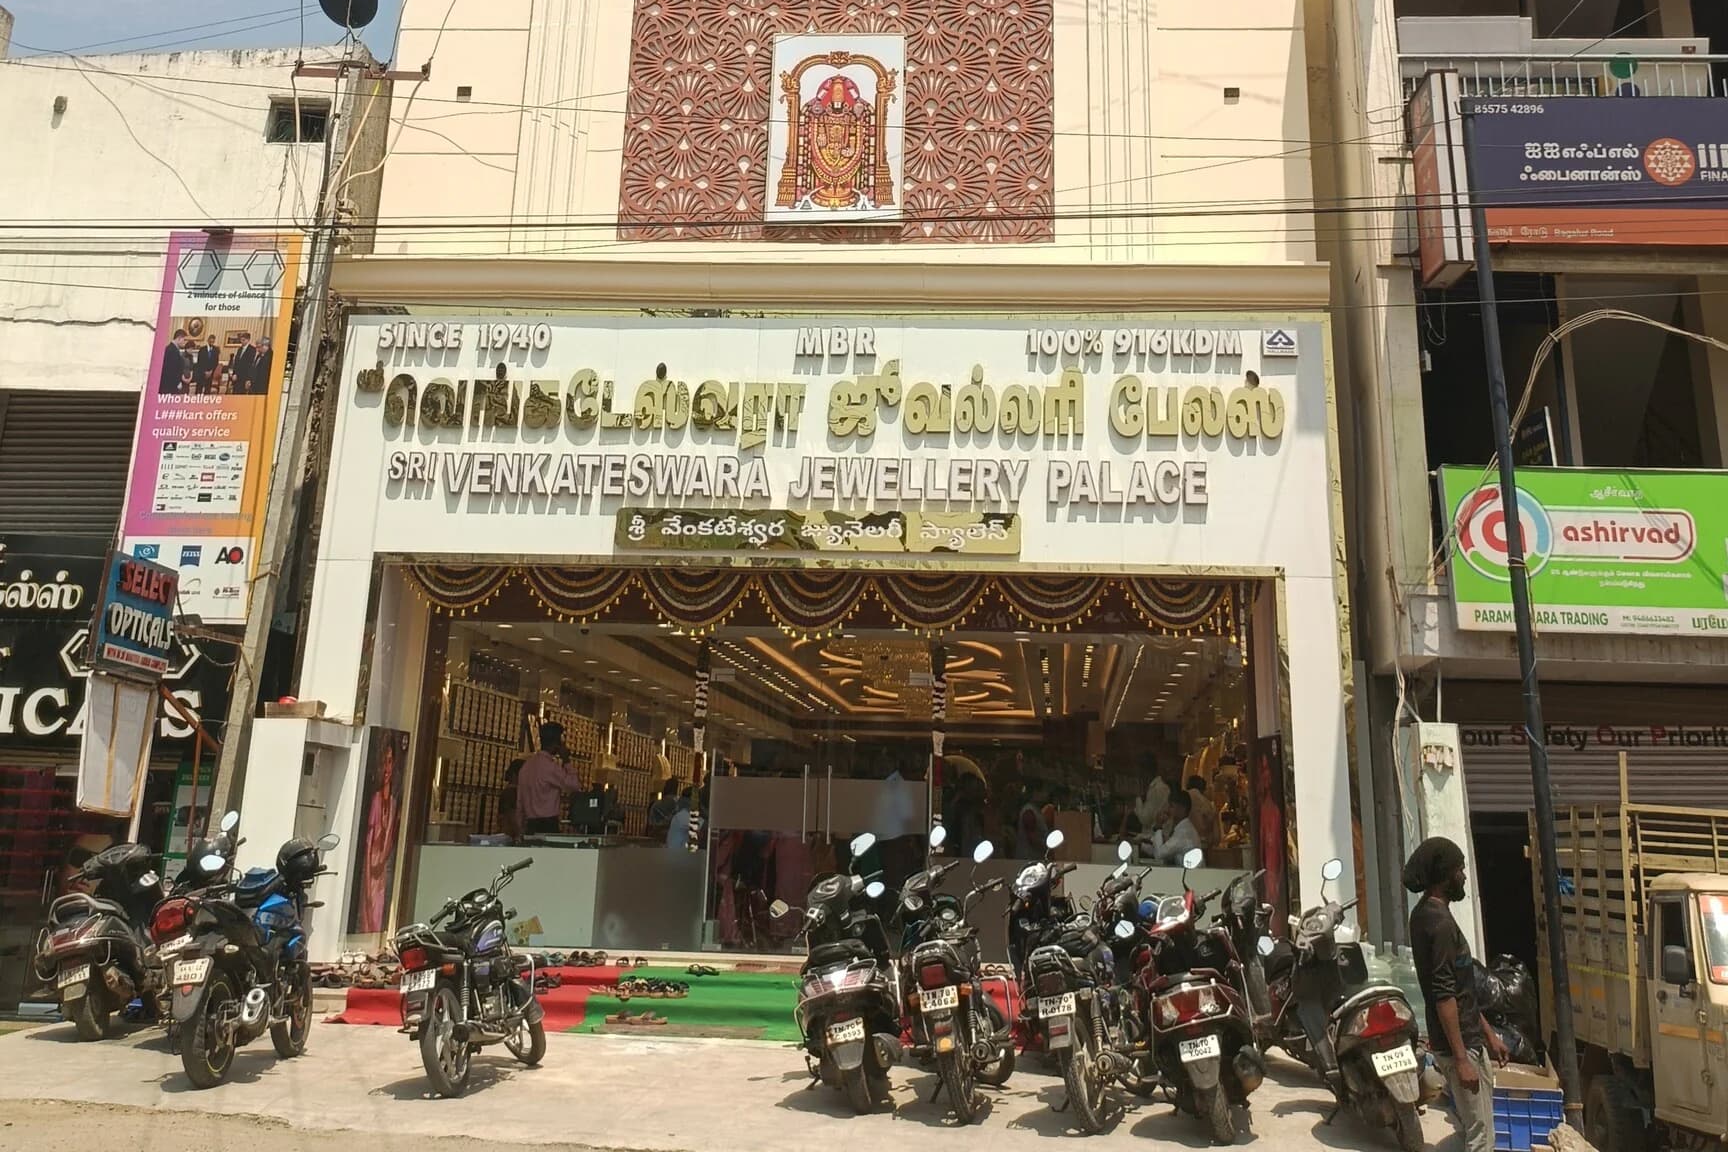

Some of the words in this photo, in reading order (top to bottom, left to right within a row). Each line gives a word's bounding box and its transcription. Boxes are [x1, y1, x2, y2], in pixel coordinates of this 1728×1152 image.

[1510, 104, 1545, 114] 42896
[205, 303, 217, 312] for
[218, 303, 240, 312] those
[378, 323, 463, 350] SINCE
[478, 323, 552, 350] 1940
[796, 327, 876, 356] MBR
[1025, 328, 1104, 356] 100%
[1113, 328, 1243, 356] 916KDM
[157, 394, 180, 404] Who
[184, 393, 222, 405] believe
[1108, 370, 1286, 439] பேலஸ்
[206, 410, 238, 421] offers
[152, 426, 189, 440] quality
[192, 427, 230, 437] service
[388, 451, 437, 481] SRI
[443, 452, 772, 499] VENKATESWARA
[788, 456, 1030, 503] JEWELLERY
[1047, 460, 1209, 505] PALACE
[628, 515, 647, 541] శ్రీ
[1563, 520, 1681, 544] ashirvad
[110, 603, 174, 649] OPTICALS
[1474, 609, 1559, 625] PARAMARA
[1560, 611, 1609, 626] TRADING
[1510, 724, 1588, 752] Sfety
